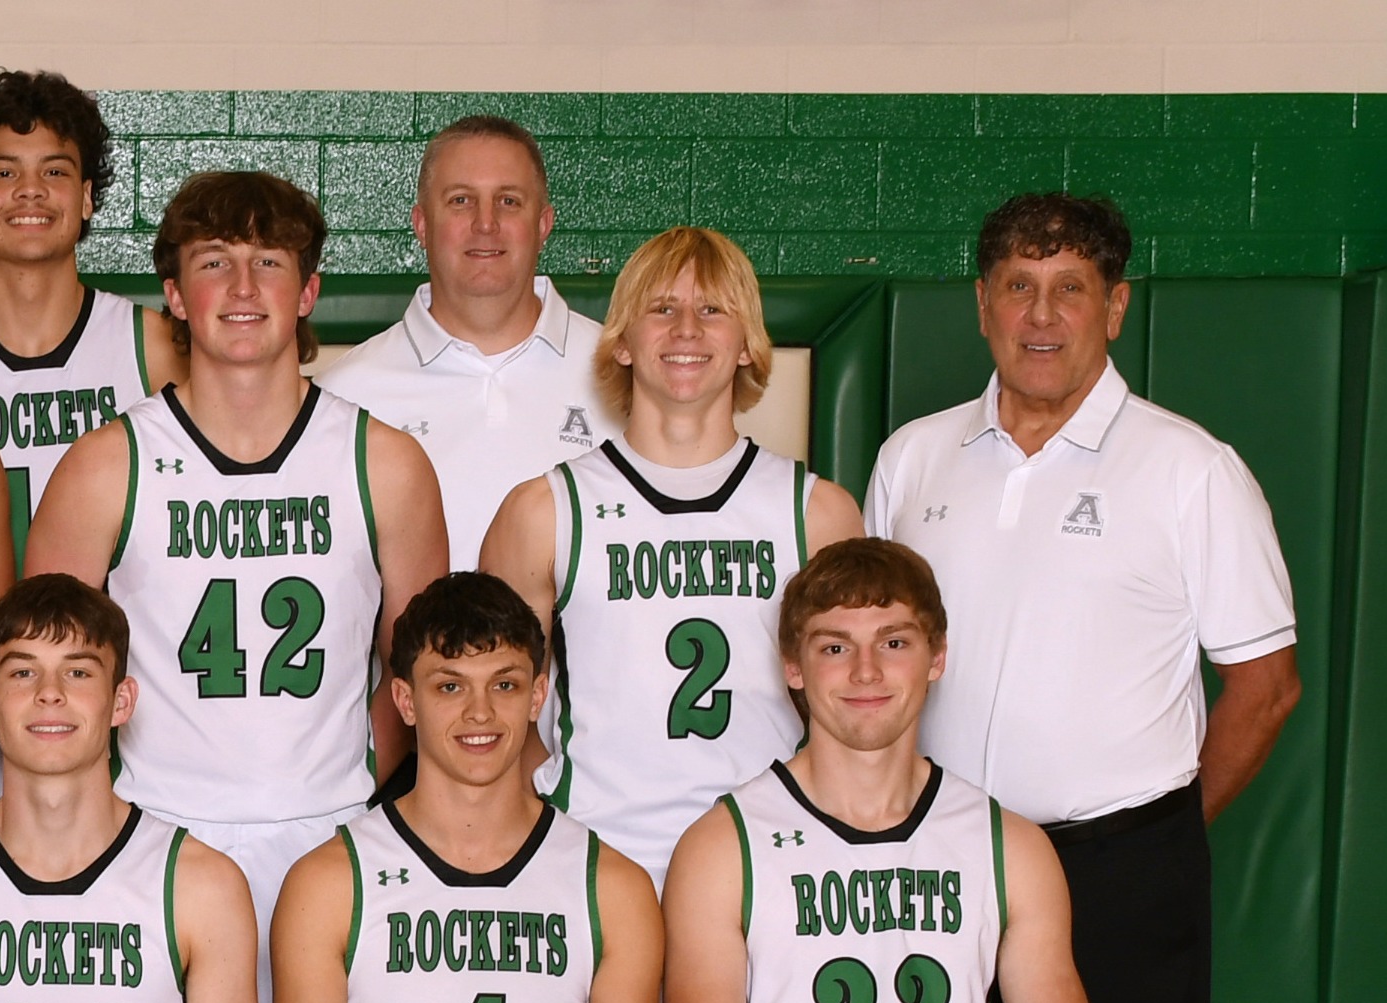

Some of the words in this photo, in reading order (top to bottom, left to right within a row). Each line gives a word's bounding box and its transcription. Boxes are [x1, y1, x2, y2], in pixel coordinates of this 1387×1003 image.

[559, 404, 593, 437] A
[559, 434, 593, 448] ROCKETS
[167, 495, 332, 560] ROCKETS
[1061, 525, 1102, 537] ROCKETS
[1063, 492, 1104, 527] A
[606, 539, 777, 601] ROCKETS
[177, 576, 326, 699] 42
[665, 617, 733, 741] 2
[791, 867, 962, 937] ROCKETS
[386, 909, 568, 977] ROCKETS
